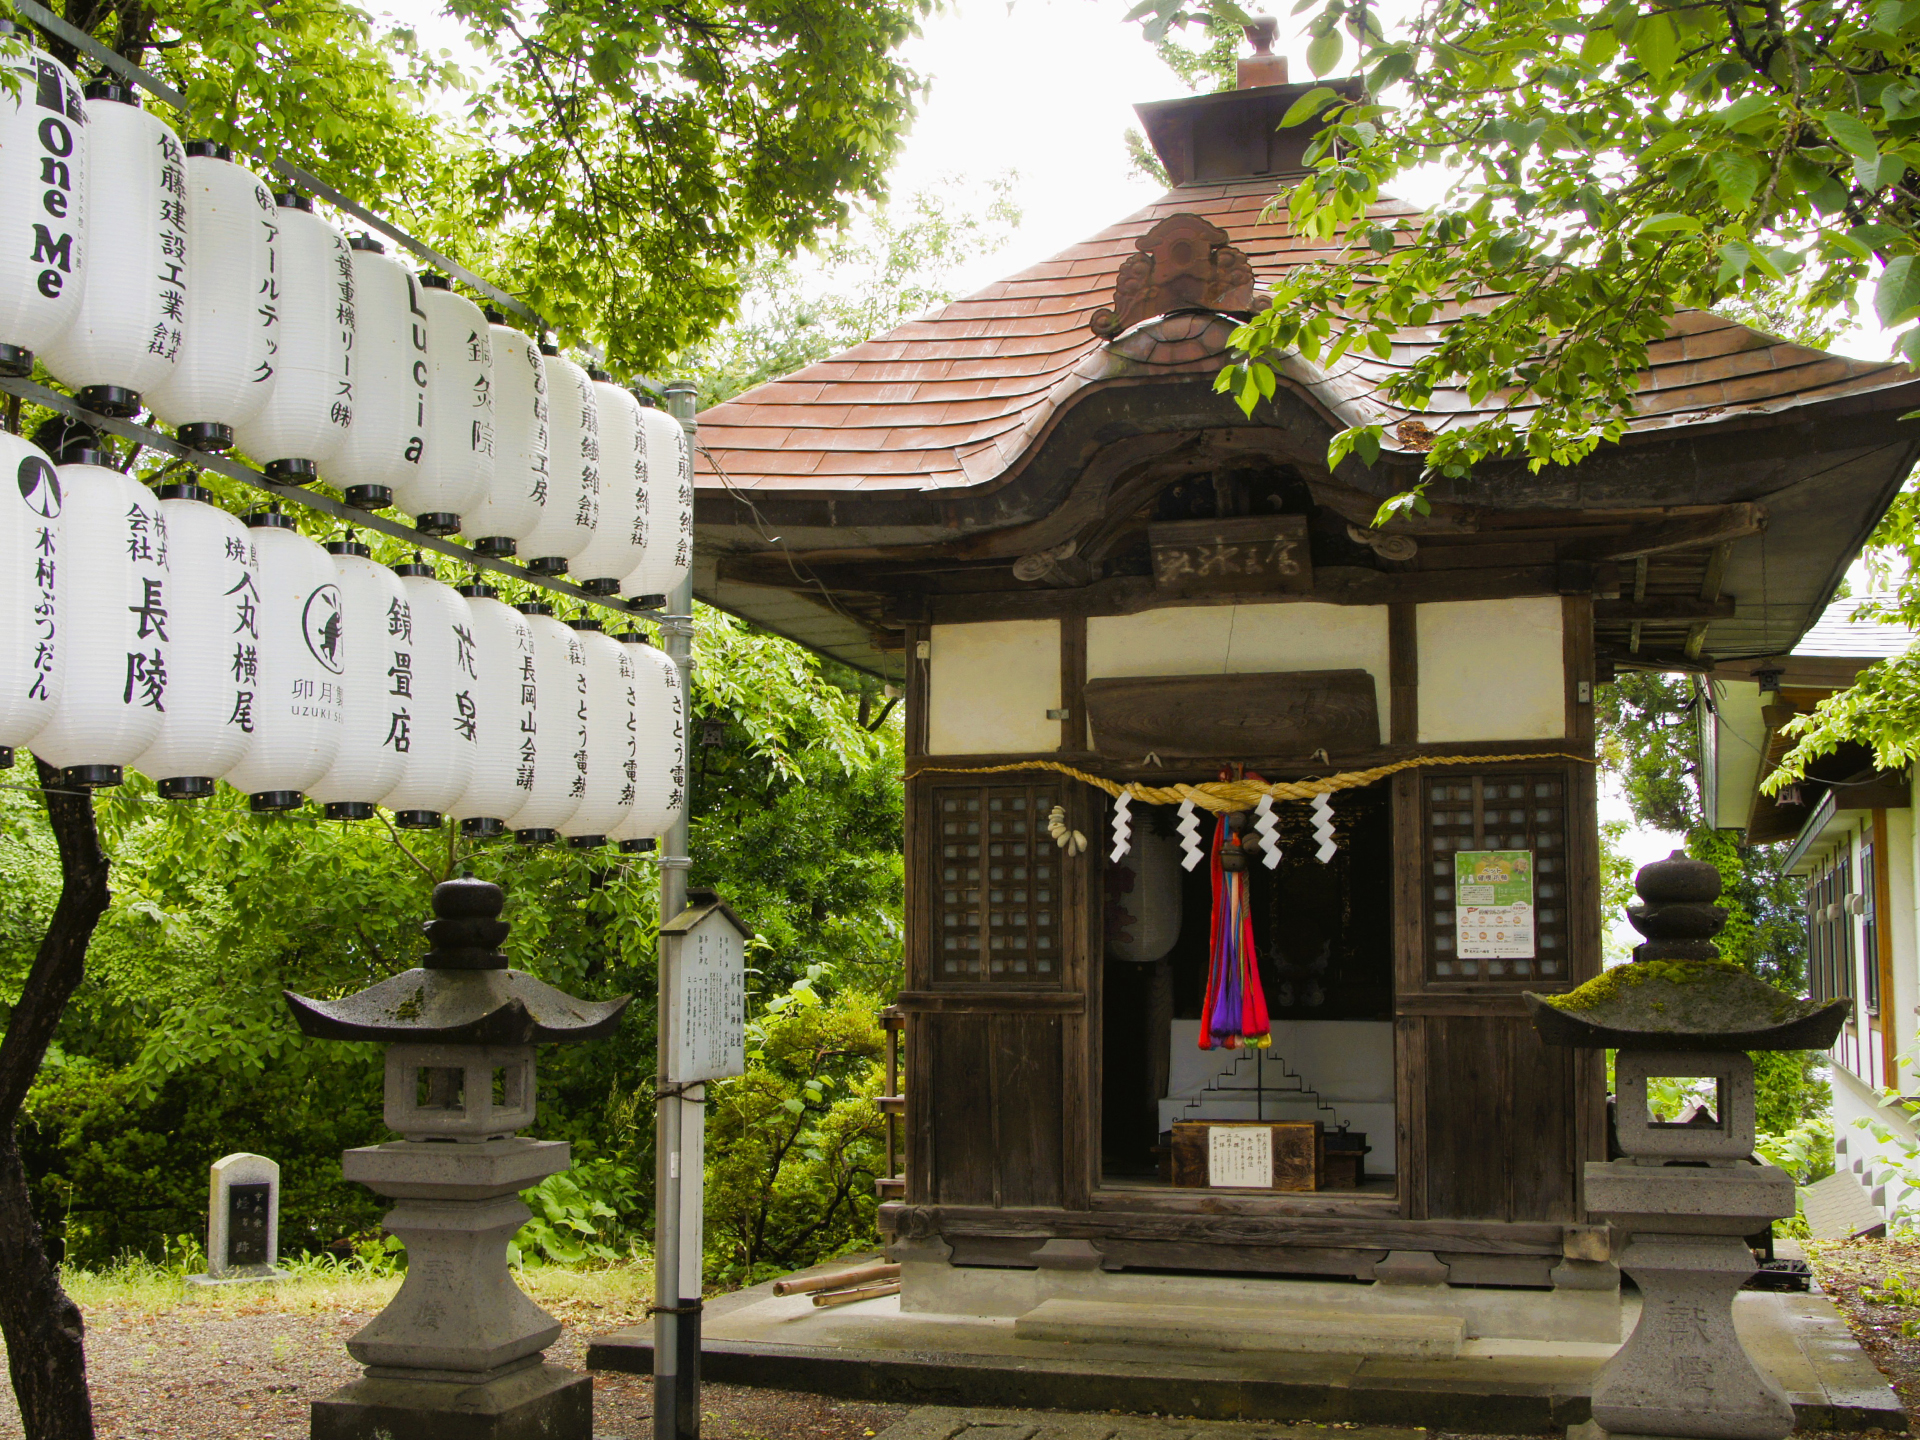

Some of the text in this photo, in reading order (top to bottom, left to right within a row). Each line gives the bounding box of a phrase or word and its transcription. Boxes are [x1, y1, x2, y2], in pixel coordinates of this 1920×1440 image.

[30, 116, 74, 299] One Me
[157, 132, 188, 325] 佐藤建設工業
[404, 273, 428, 464] Lucia
[125, 502, 153, 562] 会社
[28, 526, 57, 701] 木村ぶつだん
[123, 577, 170, 713] 長陵
[382, 596, 413, 753] 鏡畳店
[291, 705, 331, 721] UZUKI
[516, 655, 537, 792] 長岡山会議
